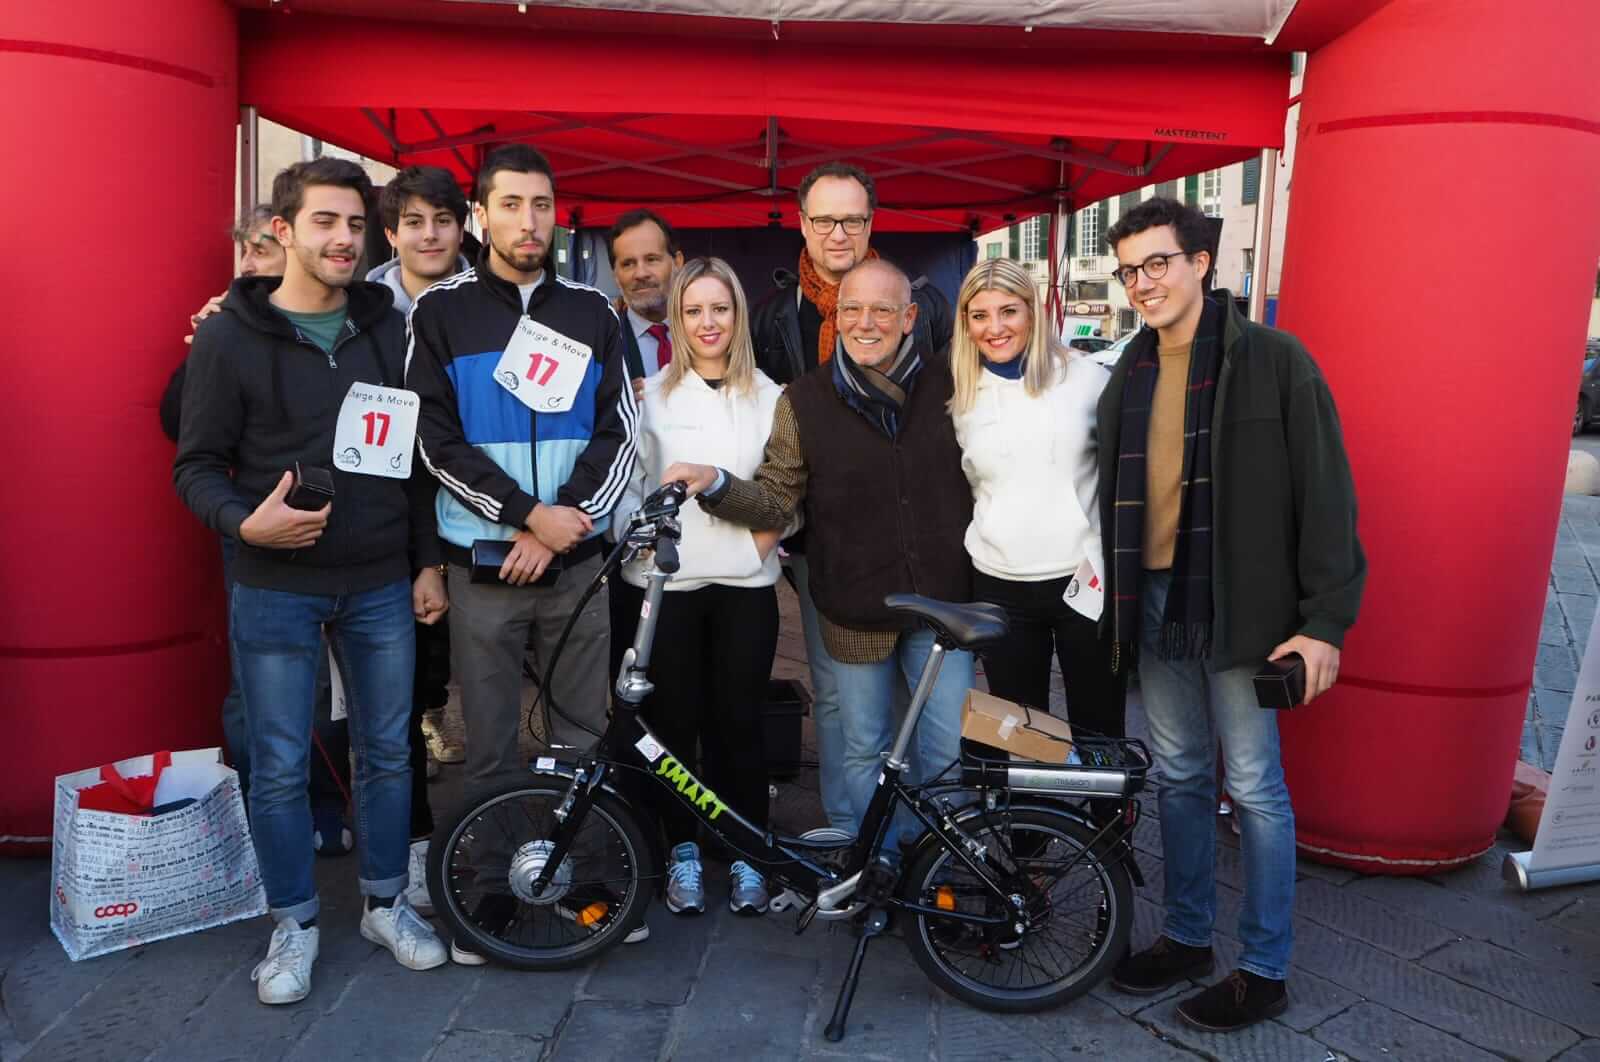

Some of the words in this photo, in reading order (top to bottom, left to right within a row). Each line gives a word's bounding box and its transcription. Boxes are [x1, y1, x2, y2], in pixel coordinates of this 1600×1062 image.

[1154, 128, 1229, 141] MASTERTENT
[520, 324, 548, 342] harge
[551, 337, 560, 346] &
[561, 342, 588, 359] Move
[526, 352, 560, 387] 17
[349, 390, 374, 403] harge
[377, 394, 384, 403] &
[387, 395, 415, 408] Move
[362, 411, 391, 448] 17
[656, 755, 729, 820] SMART
[94, 902, 138, 918] coop
